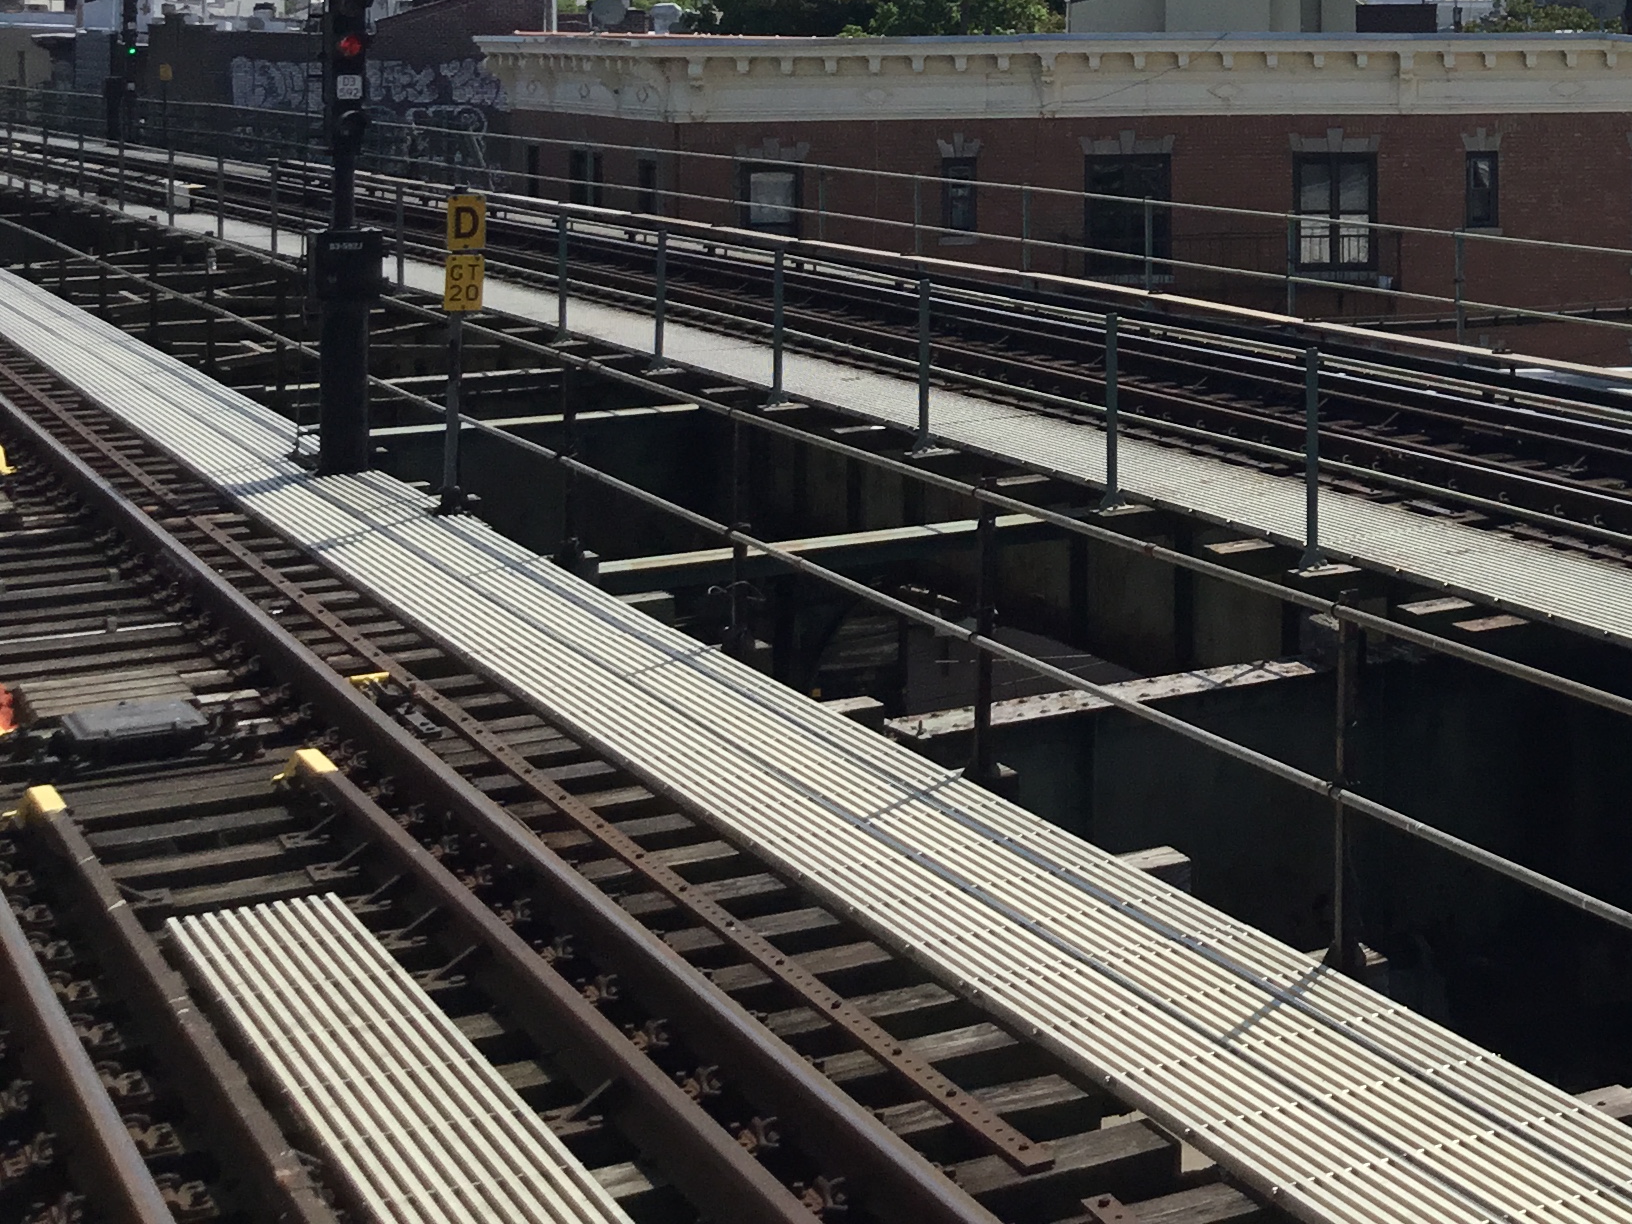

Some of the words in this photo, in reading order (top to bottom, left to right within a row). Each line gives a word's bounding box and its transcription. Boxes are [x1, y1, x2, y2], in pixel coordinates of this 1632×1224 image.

[342, 76, 356, 87] D3
[454, 206, 479, 238] D
[449, 283, 479, 301] 20
